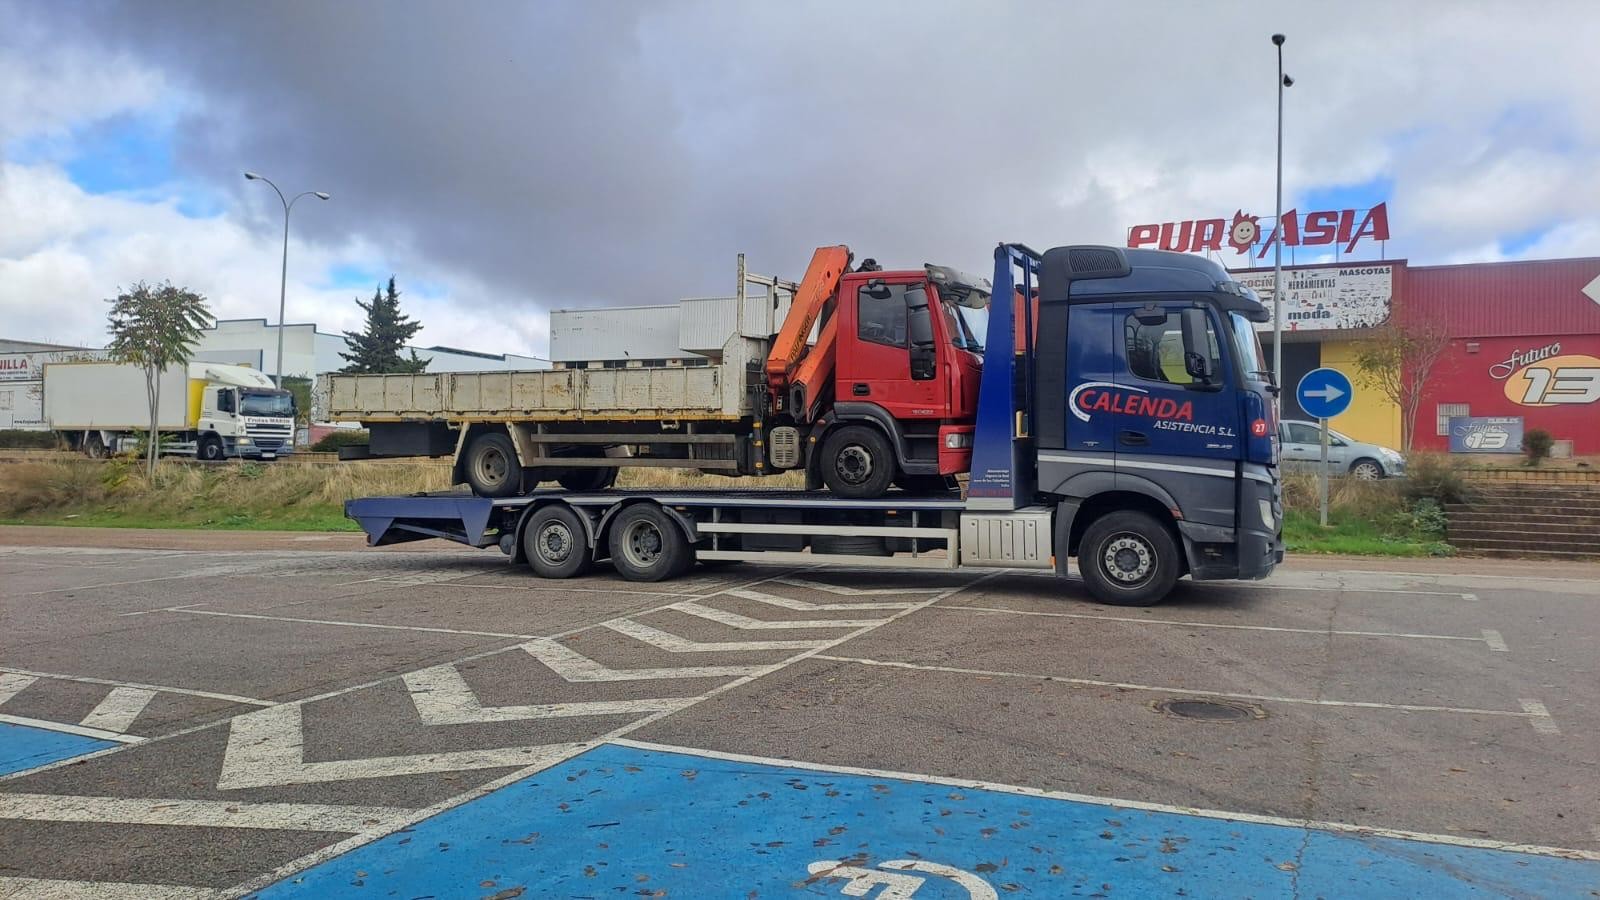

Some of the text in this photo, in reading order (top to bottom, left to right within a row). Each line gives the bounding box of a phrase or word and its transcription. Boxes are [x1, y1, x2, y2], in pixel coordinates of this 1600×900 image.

[1339, 267, 1391, 277] MASCOTAS
[1288, 279, 1336, 289] HERRAMIENTAS
[1288, 309, 1331, 320] moda
[1520, 367, 1600, 404] 13
[1078, 390, 1193, 421] CALENDA
[1153, 420, 1236, 437] ASISTENCIA S.L.
[1255, 423, 1266, 433] 27
[1471, 432, 1509, 449] 13
